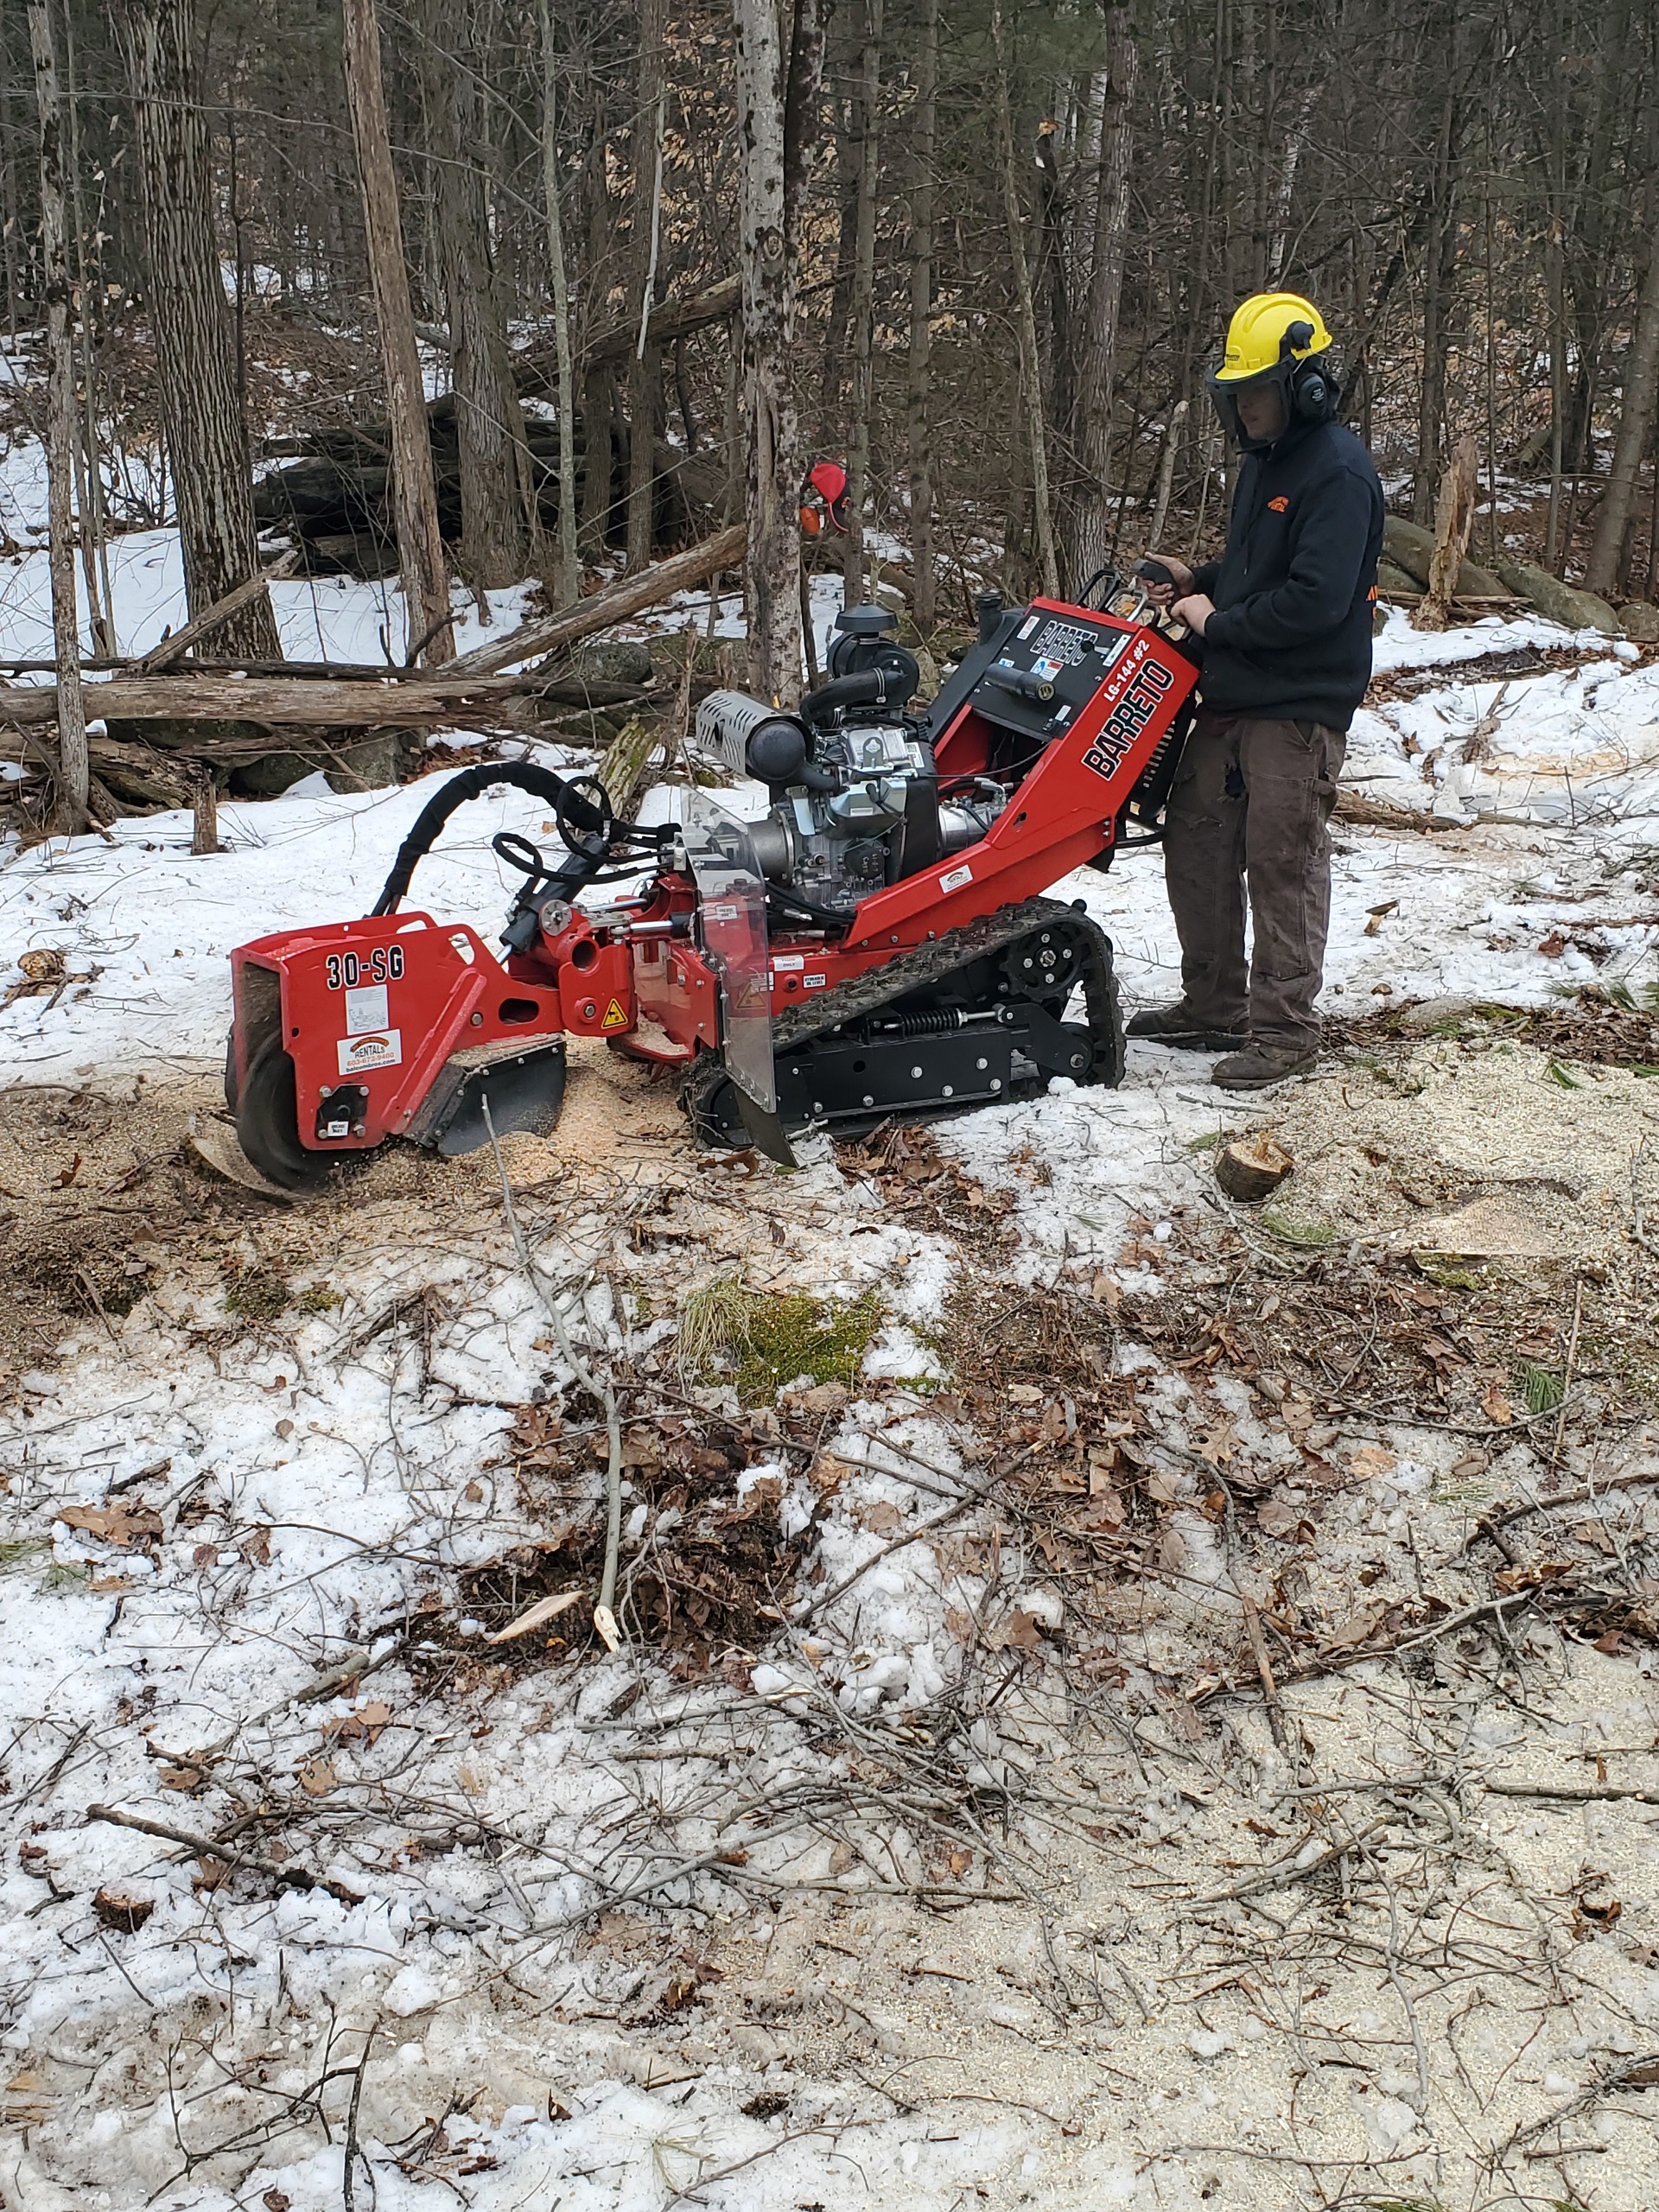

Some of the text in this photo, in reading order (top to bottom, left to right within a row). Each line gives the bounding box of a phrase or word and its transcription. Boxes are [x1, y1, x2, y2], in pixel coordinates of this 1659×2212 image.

[1103, 658, 1136, 702] LG-144
[1134, 639, 1150, 661] #2
[1081, 658, 1174, 781] BARRETO
[326, 944, 405, 990] 30-SG
[346, 1059, 396, 1072] balcombros.com
[354, 1045, 385, 1058] RENTALS
